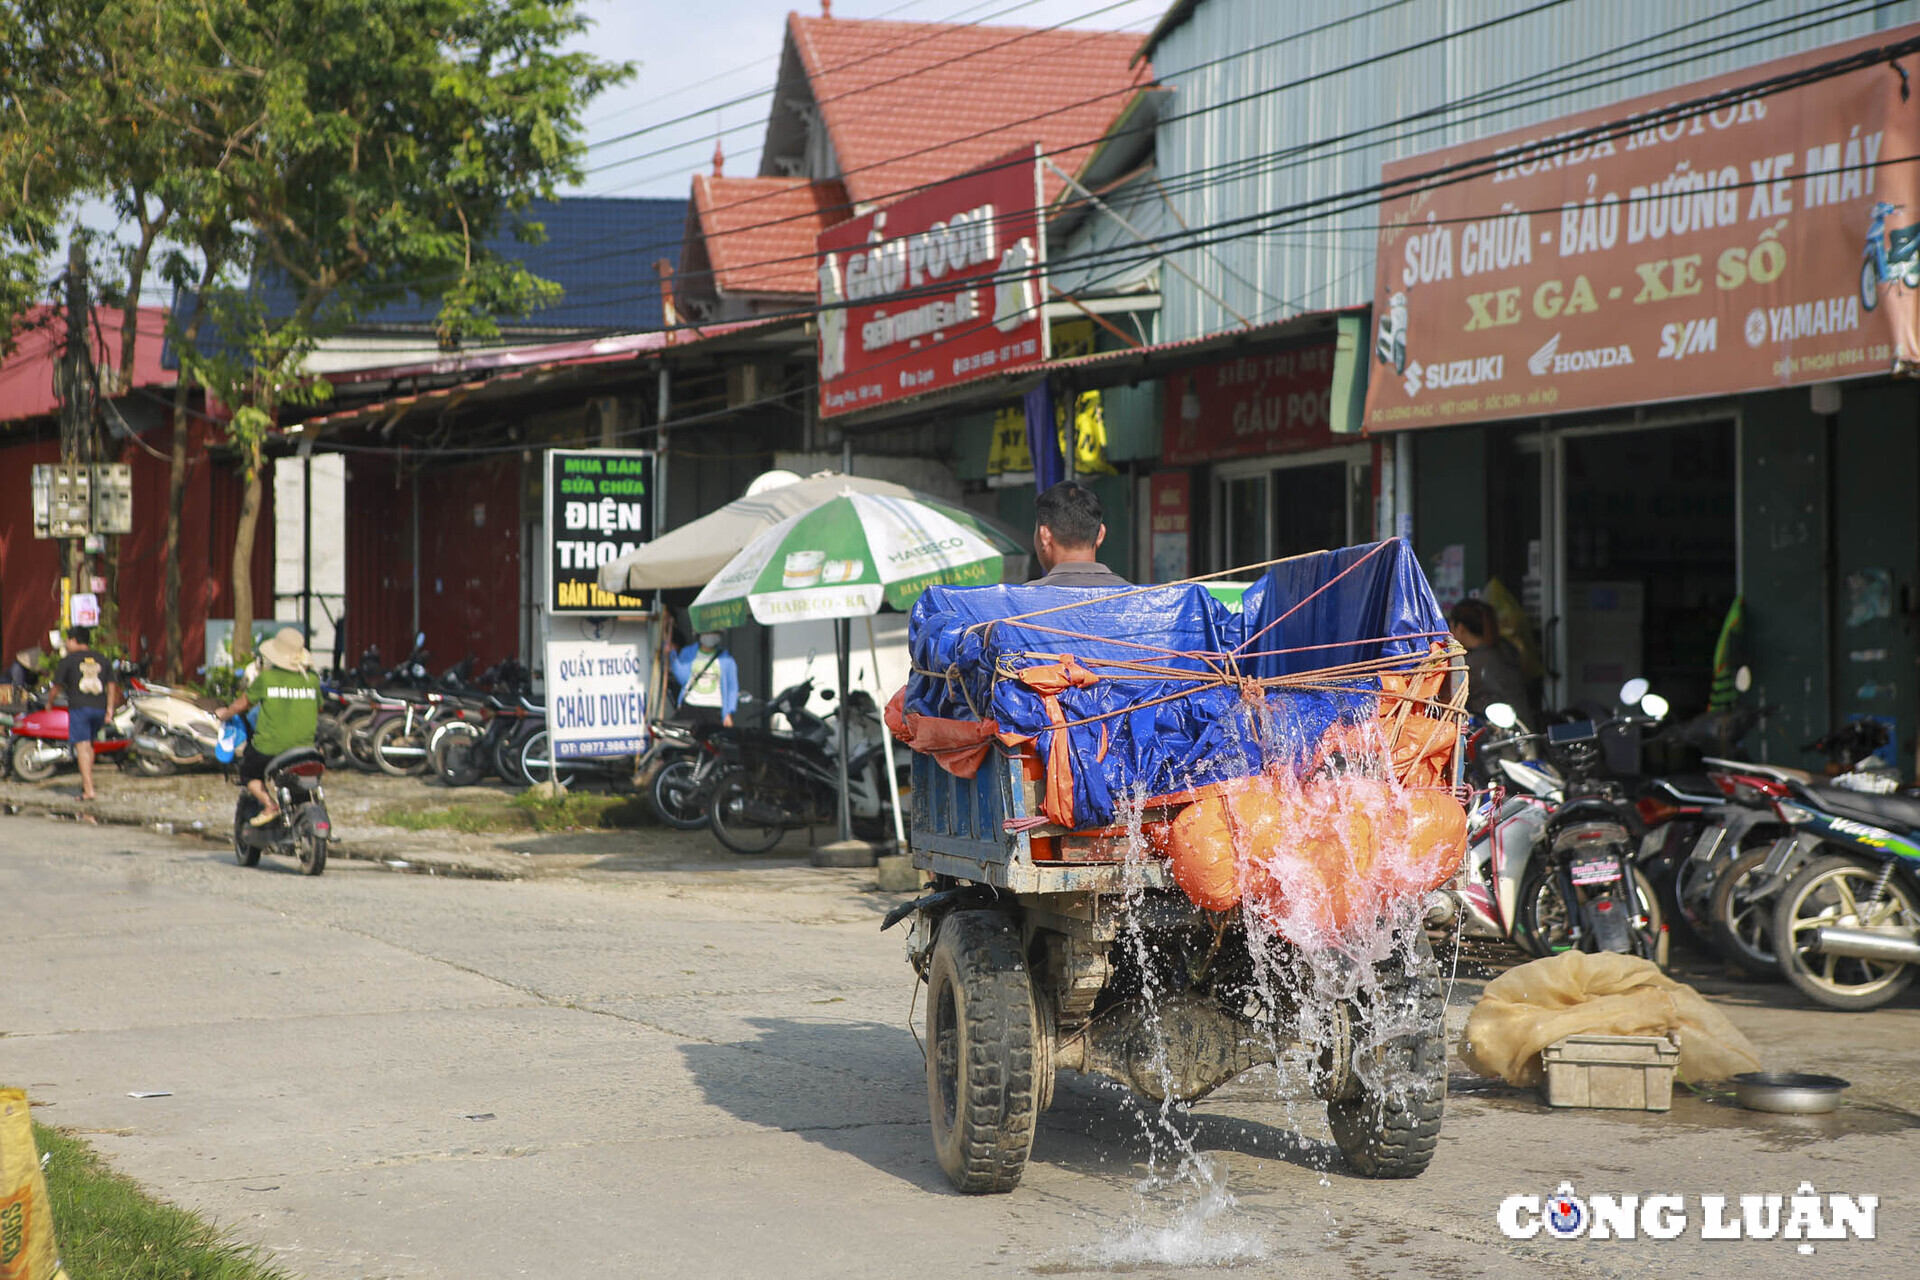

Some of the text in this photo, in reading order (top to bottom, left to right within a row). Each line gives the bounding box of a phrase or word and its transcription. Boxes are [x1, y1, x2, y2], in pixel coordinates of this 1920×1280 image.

[1402, 210, 1453, 287] SỬA
[1460, 202, 1533, 279] CHỮA
[1559, 173, 1619, 258] BẢO
[1628, 160, 1736, 243] DƯỠNG
[1748, 153, 1794, 222] XE
[1804, 125, 1884, 210] MÁY
[1463, 287, 1521, 332] XE
[1532, 274, 1599, 321] GA
[1633, 254, 1703, 305] XE
[1715, 219, 1788, 290] SỐ
[1425, 295, 1859, 389] SUZUKI HONDA SYM YAMAHA
[564, 458, 603, 474] MUA
[564, 497, 642, 536] ĐIỆN
[888, 537, 964, 563] HABECO
[558, 579, 588, 607] BÁN
[770, 597, 833, 615] HABECO
[598, 649, 641, 677] THUỐC
[556, 687, 596, 729] CHÂU
